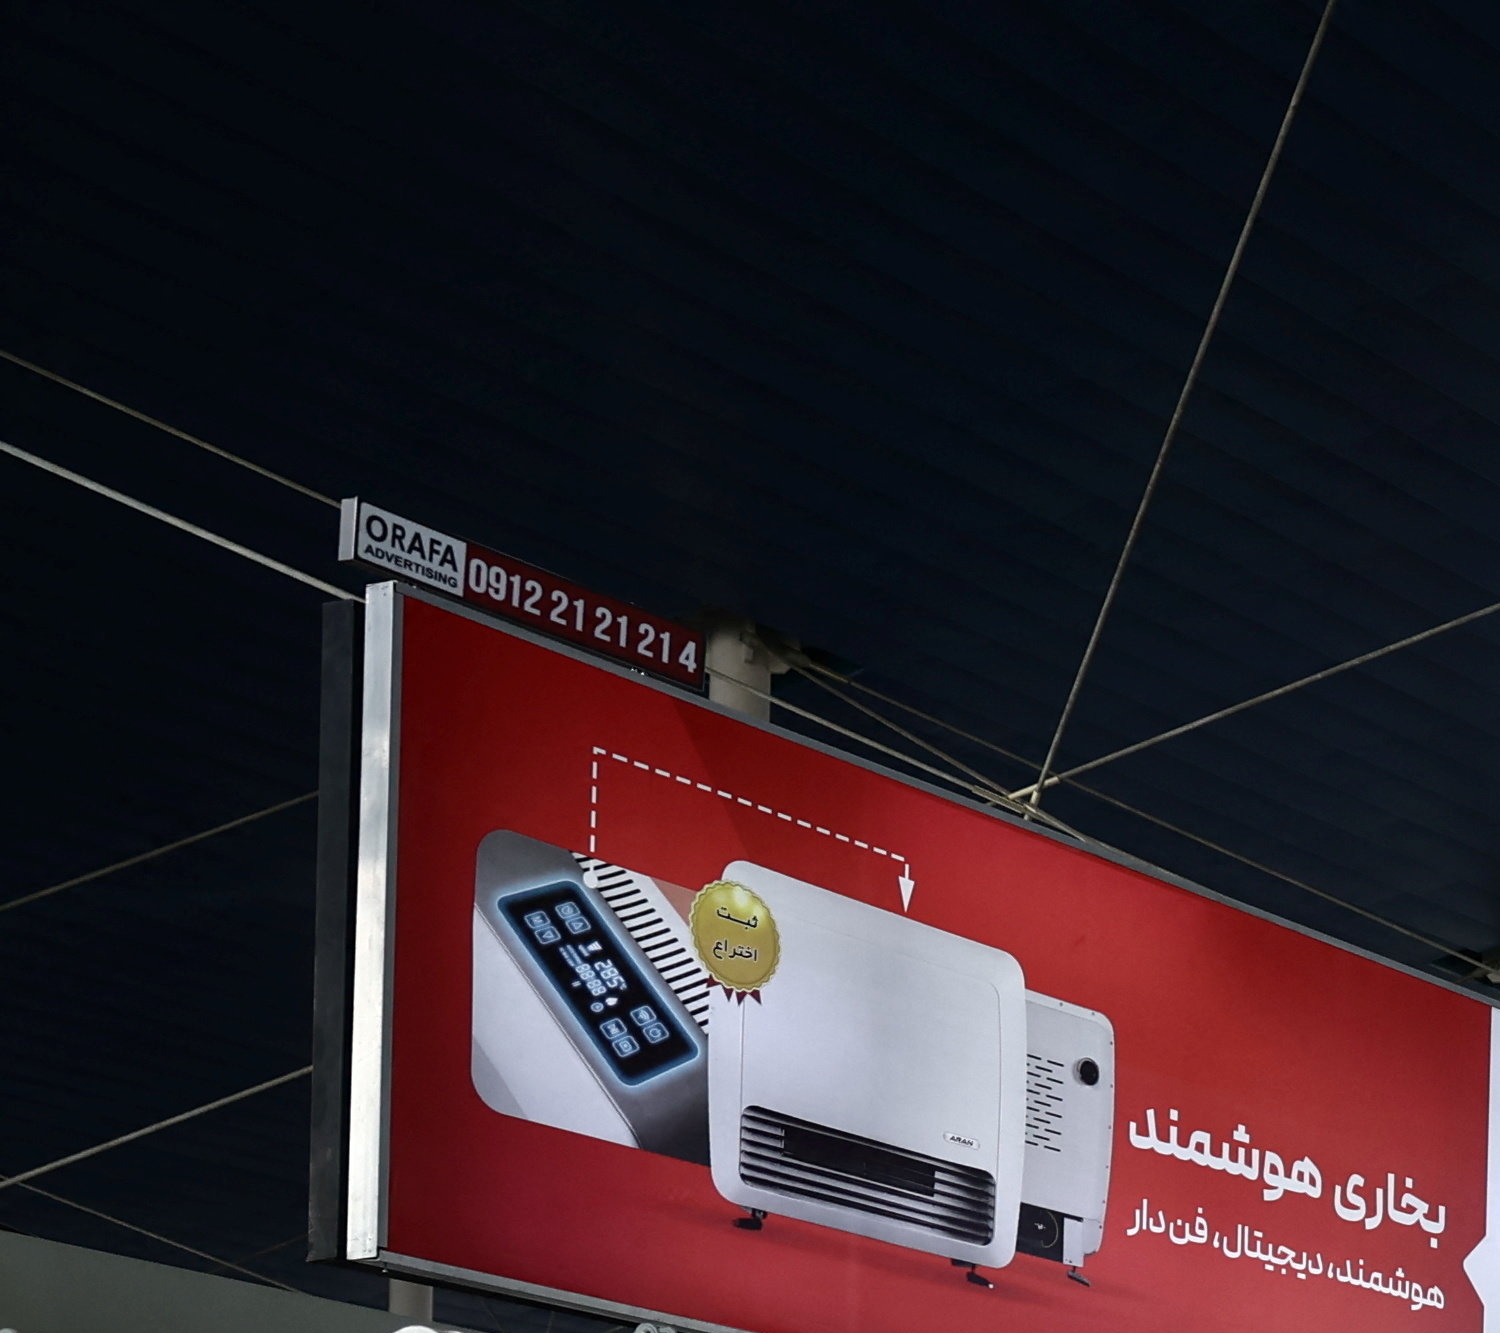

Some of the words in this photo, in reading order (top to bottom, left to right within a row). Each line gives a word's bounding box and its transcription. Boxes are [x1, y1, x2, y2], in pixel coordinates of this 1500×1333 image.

[363, 543, 458, 589] ADVERTISING
[365, 515, 458, 573] ORAFA
[468, 558, 542, 616] 0912
[716, 904, 759, 930] ثبت
[712, 939, 758, 962] اختراع
[948, 1134, 975, 1149] ARAN
[1128, 1108, 1323, 1202] هوشمند
[1333, 1171, 1446, 1249] بخاری
